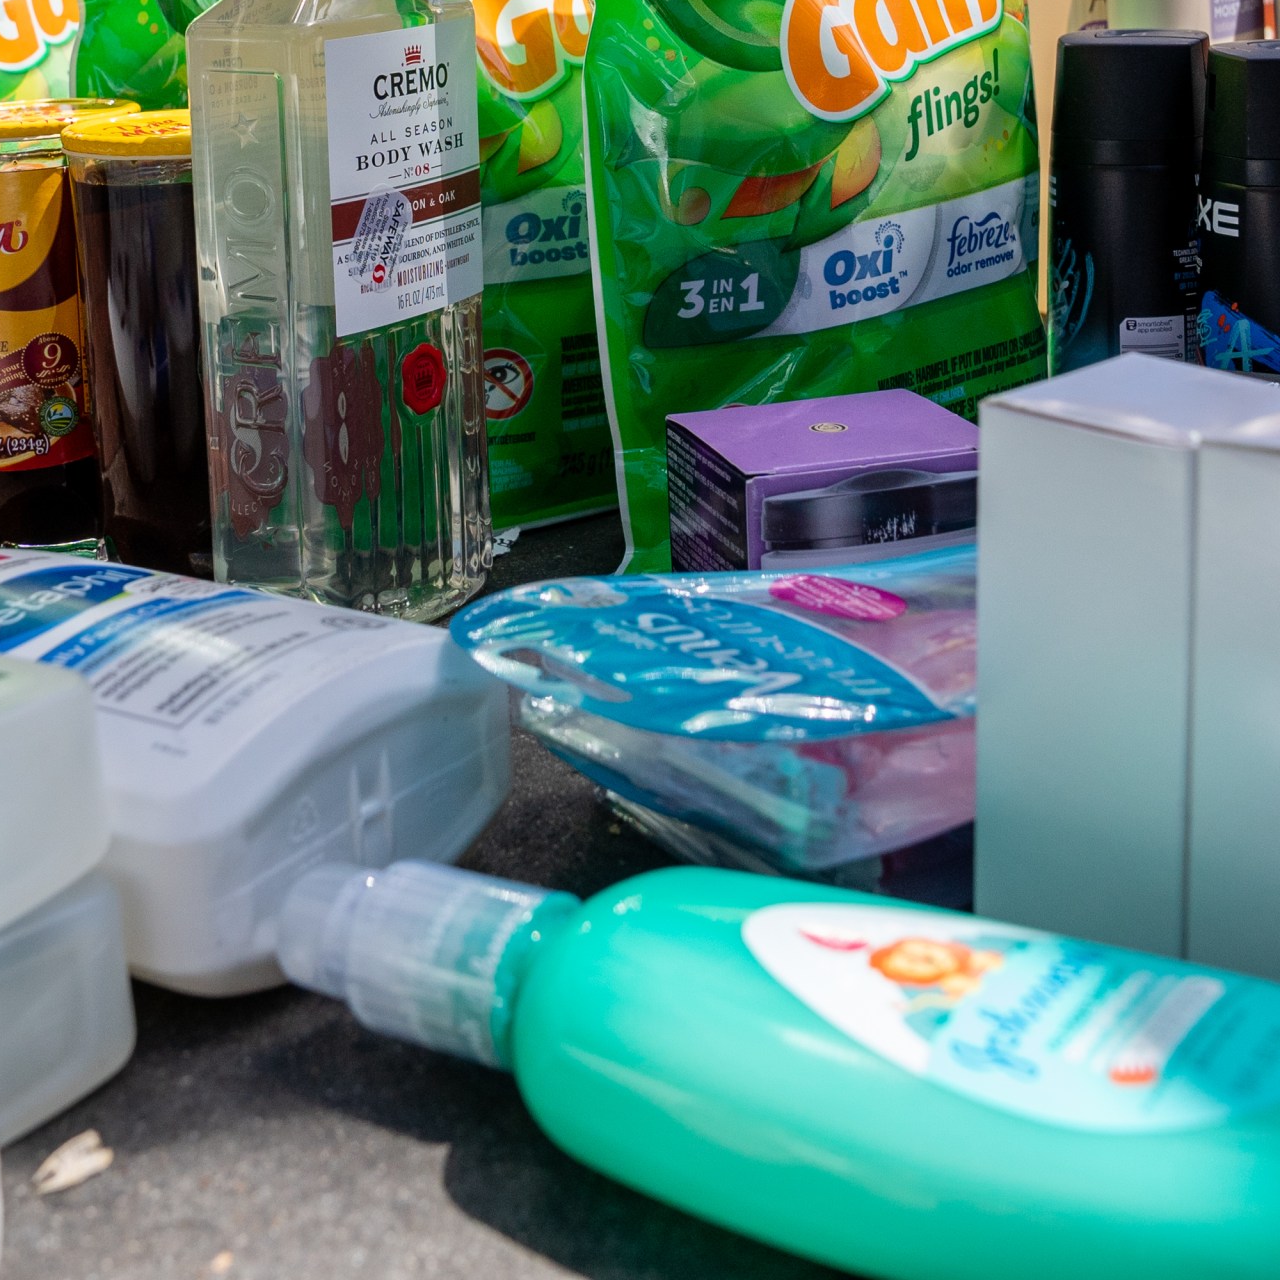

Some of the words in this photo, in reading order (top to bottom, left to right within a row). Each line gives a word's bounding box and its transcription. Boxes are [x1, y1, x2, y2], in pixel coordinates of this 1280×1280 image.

[373, 63, 449, 101] CREMO
[905, 48, 1001, 162] flings!
[370, 129, 397, 145] ALL
[405, 117, 453, 138] SEASON
[356, 146, 412, 171] BODY
[418, 132, 464, 158] WASH
[415, 163, 430, 177] 08
[438, 189, 456, 205] OAK
[379, 199, 405, 266] SAFEWAY
[505, 201, 582, 245] Oxi
[399, 247, 432, 265] OURBON,
[432, 244, 446, 256] AND
[446, 237, 464, 250] WHITE
[465, 232, 476, 244] OAK
[404, 237, 424, 249] LEND
[425, 235, 434, 244] OF
[510, 240, 589, 266] boost
[947, 215, 1012, 266] febreze
[397, 260, 444, 287] MOISTURIZING
[823, 235, 895, 287] Oxi
[946, 261, 973, 279] odor
[974, 249, 1014, 273] remover
[677, 281, 706, 319] 3
[712, 279, 733, 294] IN
[738, 273, 766, 312] 1
[828, 280, 901, 310] boost
[709, 296, 734, 313] EN
[1, 361, 21, 376] your
[41, 342, 62, 369] 9
[958, 351, 973, 370] PUT
[973, 348, 983, 365] IN
[982, 341, 1008, 362] MOUTH
[1008, 337, 1019, 355] OR
[6, 433, 50, 456] (234g)
